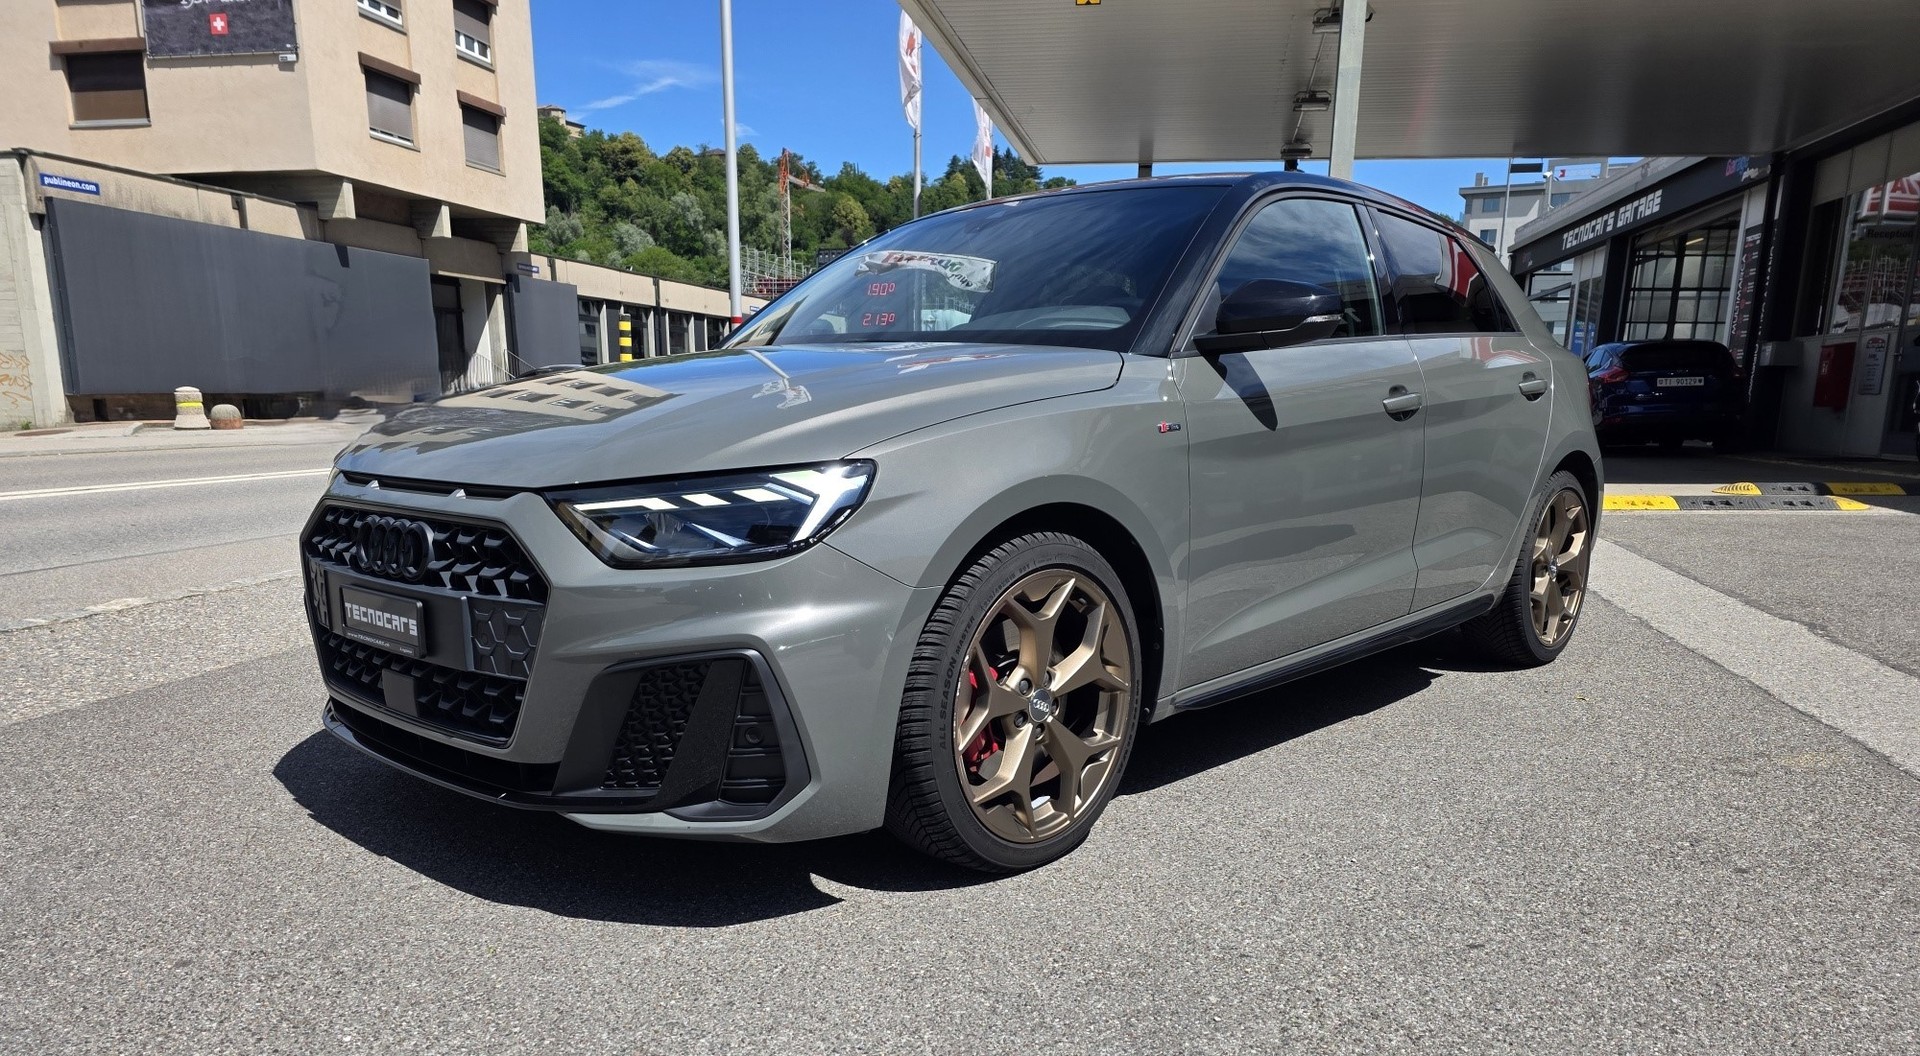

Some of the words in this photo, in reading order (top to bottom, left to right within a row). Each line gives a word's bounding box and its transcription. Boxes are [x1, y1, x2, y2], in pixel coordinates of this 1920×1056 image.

[43, 176, 97, 191] publineon.com
[1562, 210, 1616, 251] TECNOCARS
[1617, 189, 1663, 228] GARAGE
[1867, 228, 1914, 239] Reception
[345, 602, 418, 637] TECNOCARS
[940, 657, 957, 720] SEASON
[955, 615, 976, 655] MASTER
